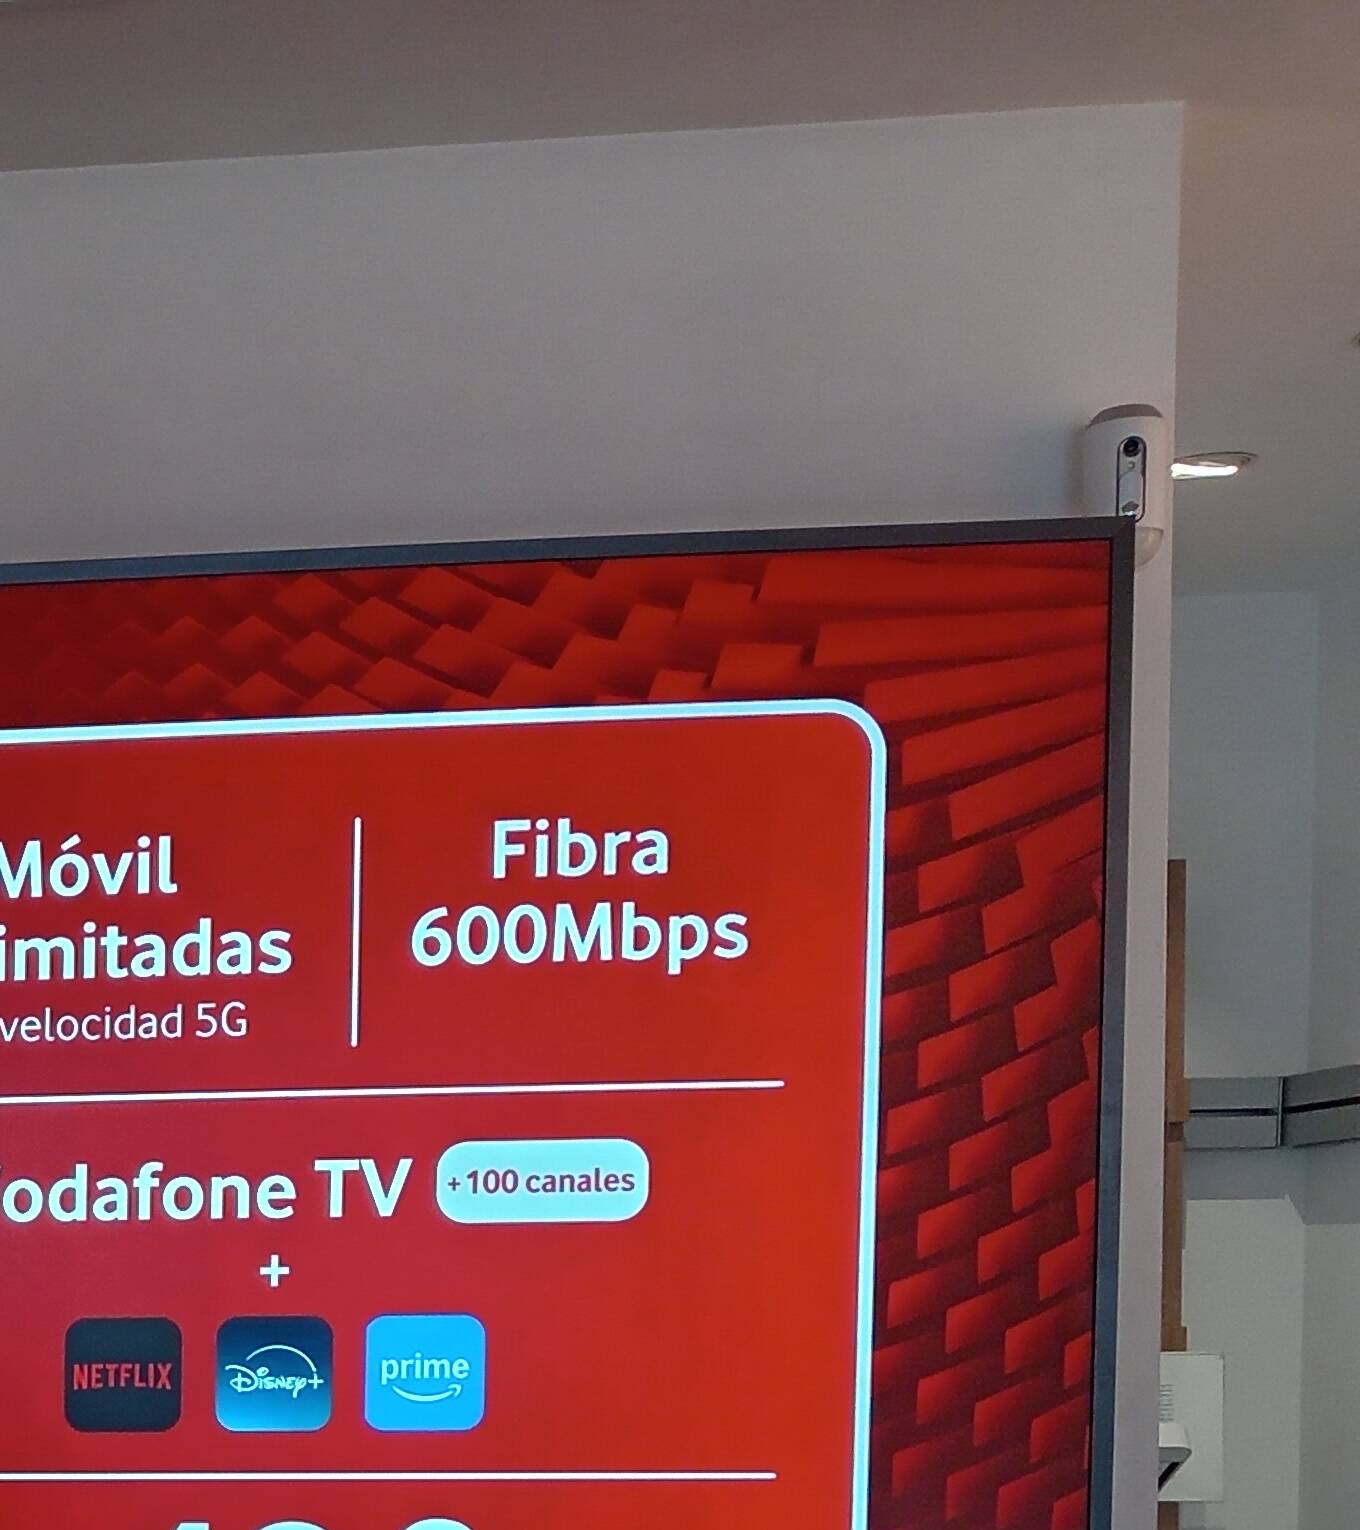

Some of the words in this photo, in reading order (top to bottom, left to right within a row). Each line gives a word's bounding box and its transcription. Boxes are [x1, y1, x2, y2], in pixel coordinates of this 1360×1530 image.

[493, 817, 669, 879] Fibra
[411, 901, 749, 975] 600Mbps
[195, 1001, 247, 1038] 5G
[313, 1158, 414, 1218] TV
[525, 1167, 636, 1194] canales
[259, 1254, 290, 1288] +
[72, 1361, 172, 1391] NETFLIX
[381, 1353, 470, 1385] prime
